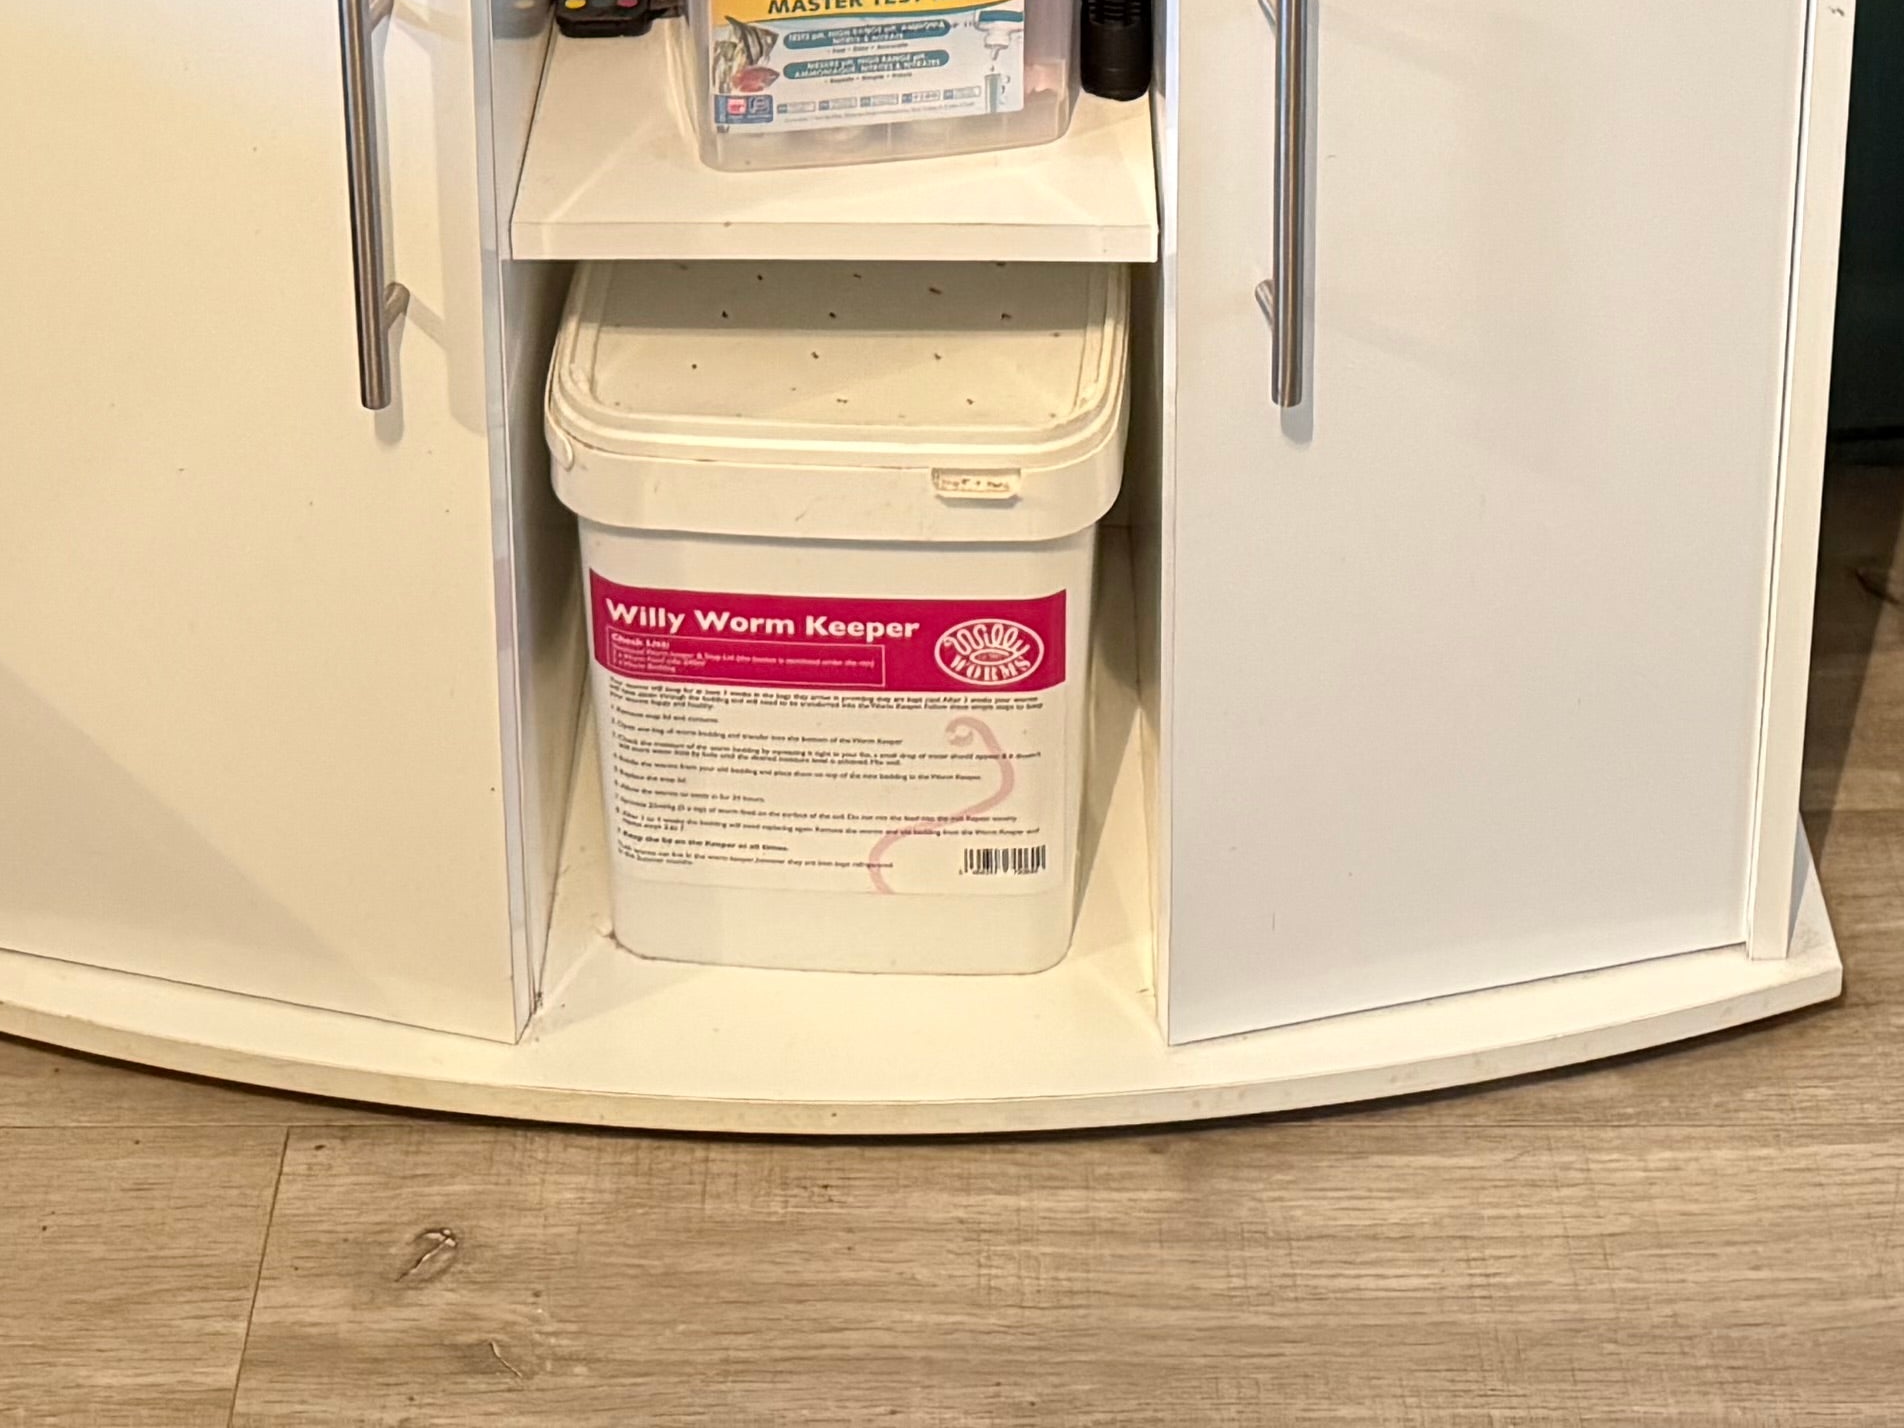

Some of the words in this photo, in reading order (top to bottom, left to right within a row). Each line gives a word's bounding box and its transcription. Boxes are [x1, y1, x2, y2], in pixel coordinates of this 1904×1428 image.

[605, 597, 686, 635] Willy
[694, 609, 795, 636] Worm
[805, 614, 920, 644] Keeper
[949, 652, 1032, 682] WORMS
